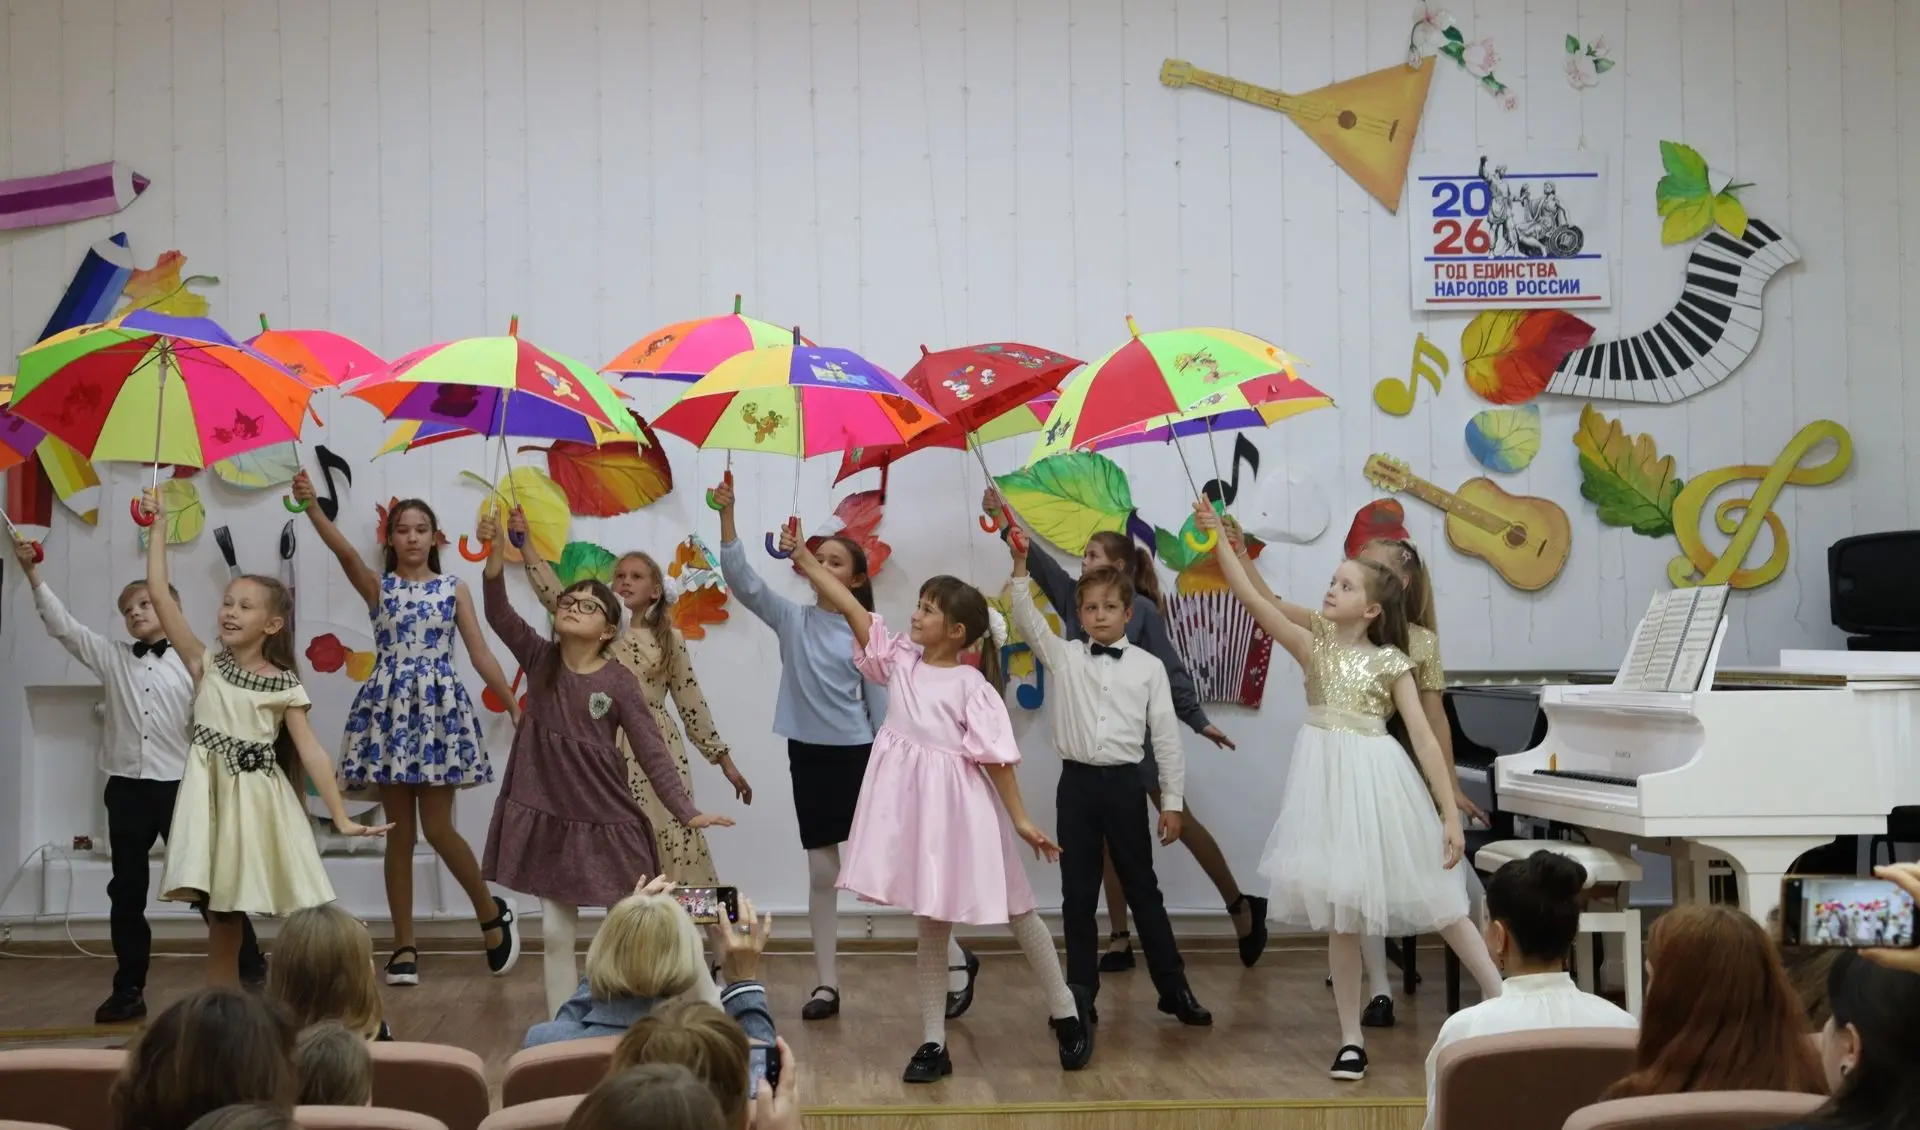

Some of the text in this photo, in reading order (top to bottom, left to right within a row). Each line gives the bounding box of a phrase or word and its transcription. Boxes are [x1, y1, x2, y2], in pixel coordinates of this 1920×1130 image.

[1431, 181, 1492, 217] 20
[1433, 218, 1491, 255] 26
[1434, 262, 1558, 280] ГОД ЕДИНСТВА
[1434, 279, 1580, 298] НАРОДОВ РОССИИ
